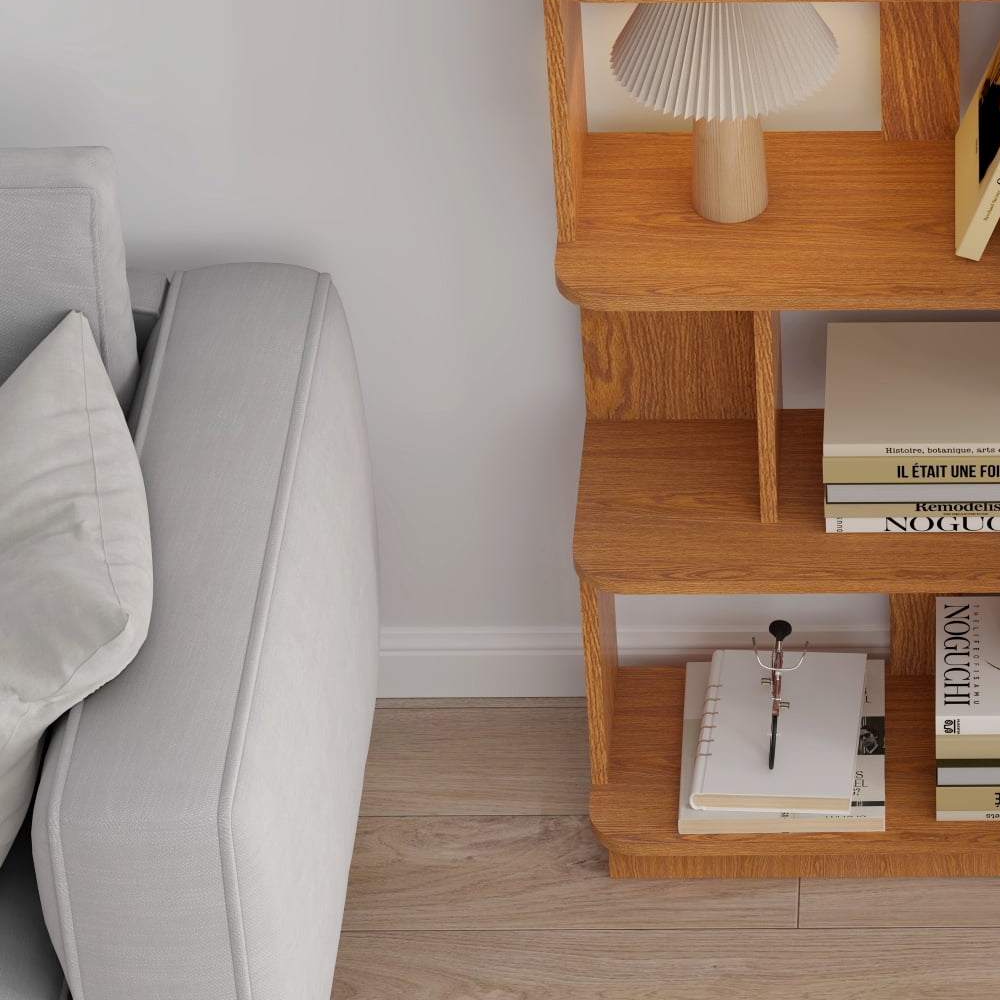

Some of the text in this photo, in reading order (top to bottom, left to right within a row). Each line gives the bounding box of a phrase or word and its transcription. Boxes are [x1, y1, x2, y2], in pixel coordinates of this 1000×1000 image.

[927, 447, 974, 455] botanique,
[897, 465, 908, 478] IL
[912, 462, 947, 478] ÉTAIT
[951, 465, 976, 478] UNE
[943, 604, 970, 706] NOGUCHI
